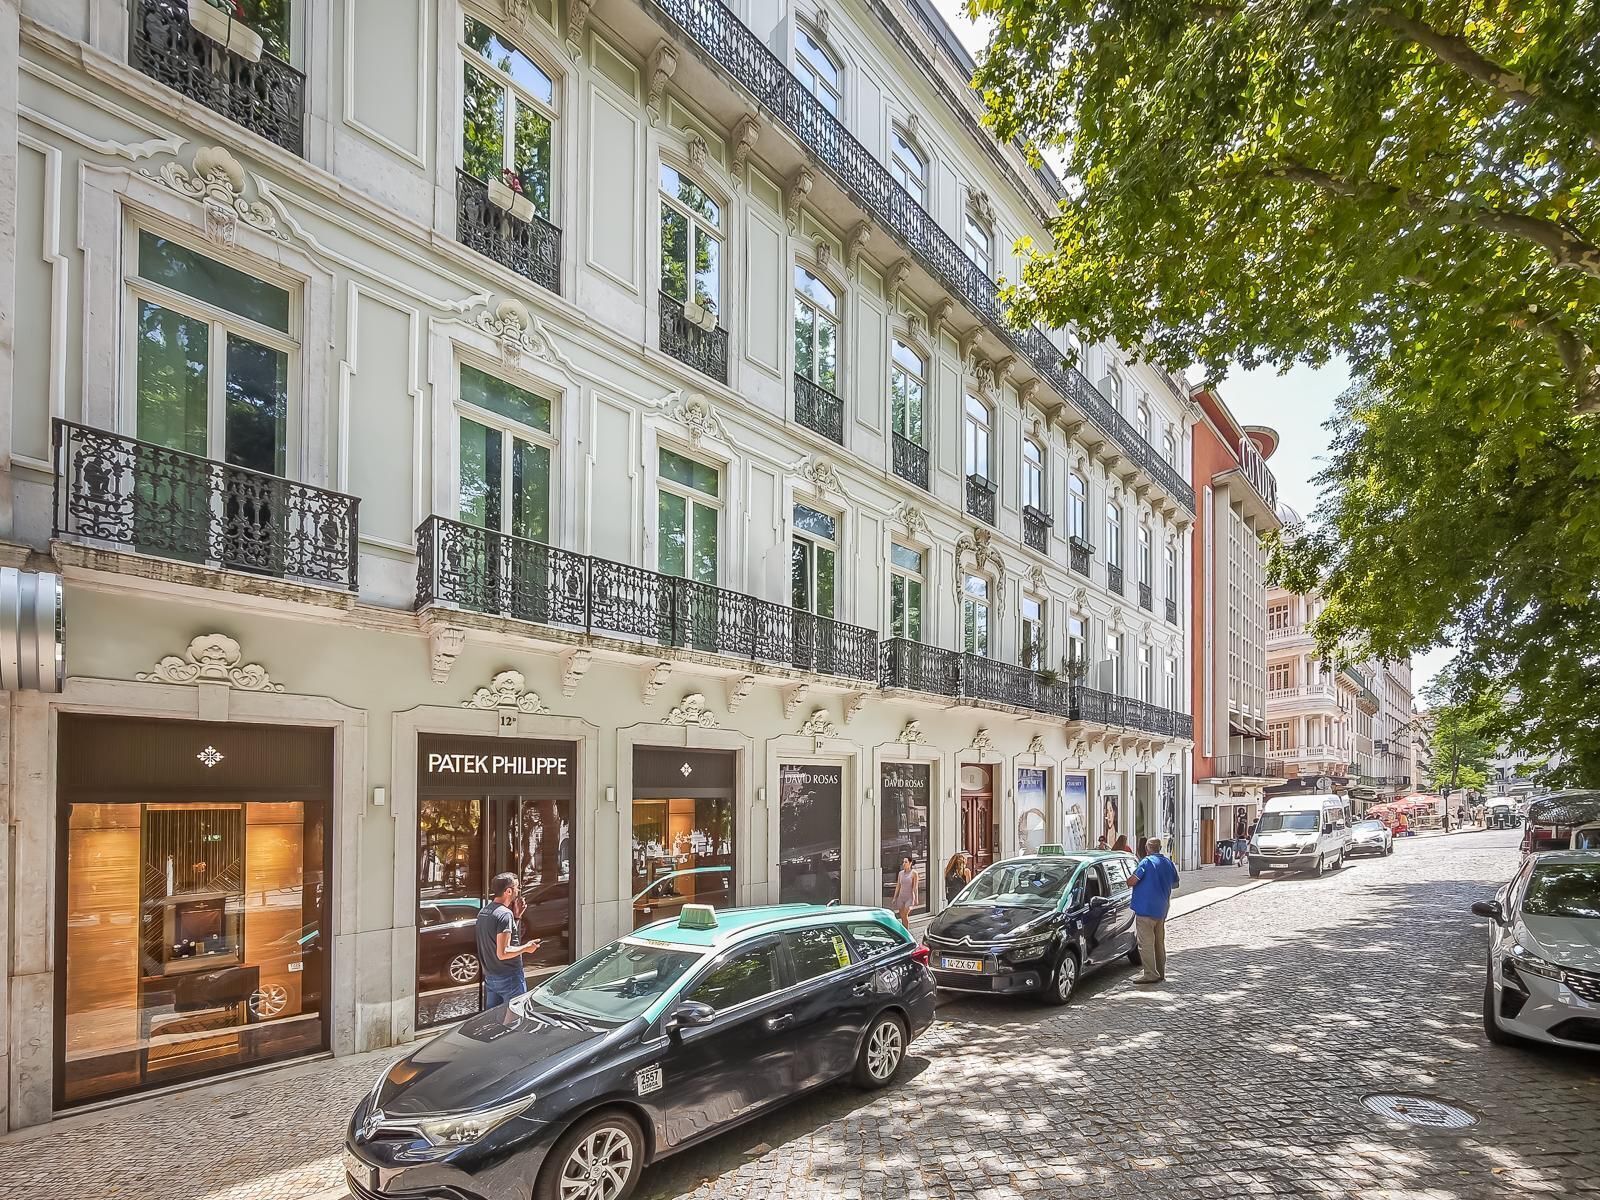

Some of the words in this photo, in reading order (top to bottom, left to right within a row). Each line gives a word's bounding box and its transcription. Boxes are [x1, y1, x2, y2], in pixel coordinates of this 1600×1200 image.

[428, 753, 489, 773] PATEK
[492, 755, 567, 775] PHILIPPE
[785, 774, 812, 784] DAVID
[813, 774, 838, 784] ROSAS
[884, 778, 904, 788] DAVID
[904, 779, 924, 788] ROSAS
[641, 1070, 658, 1084] 2557
